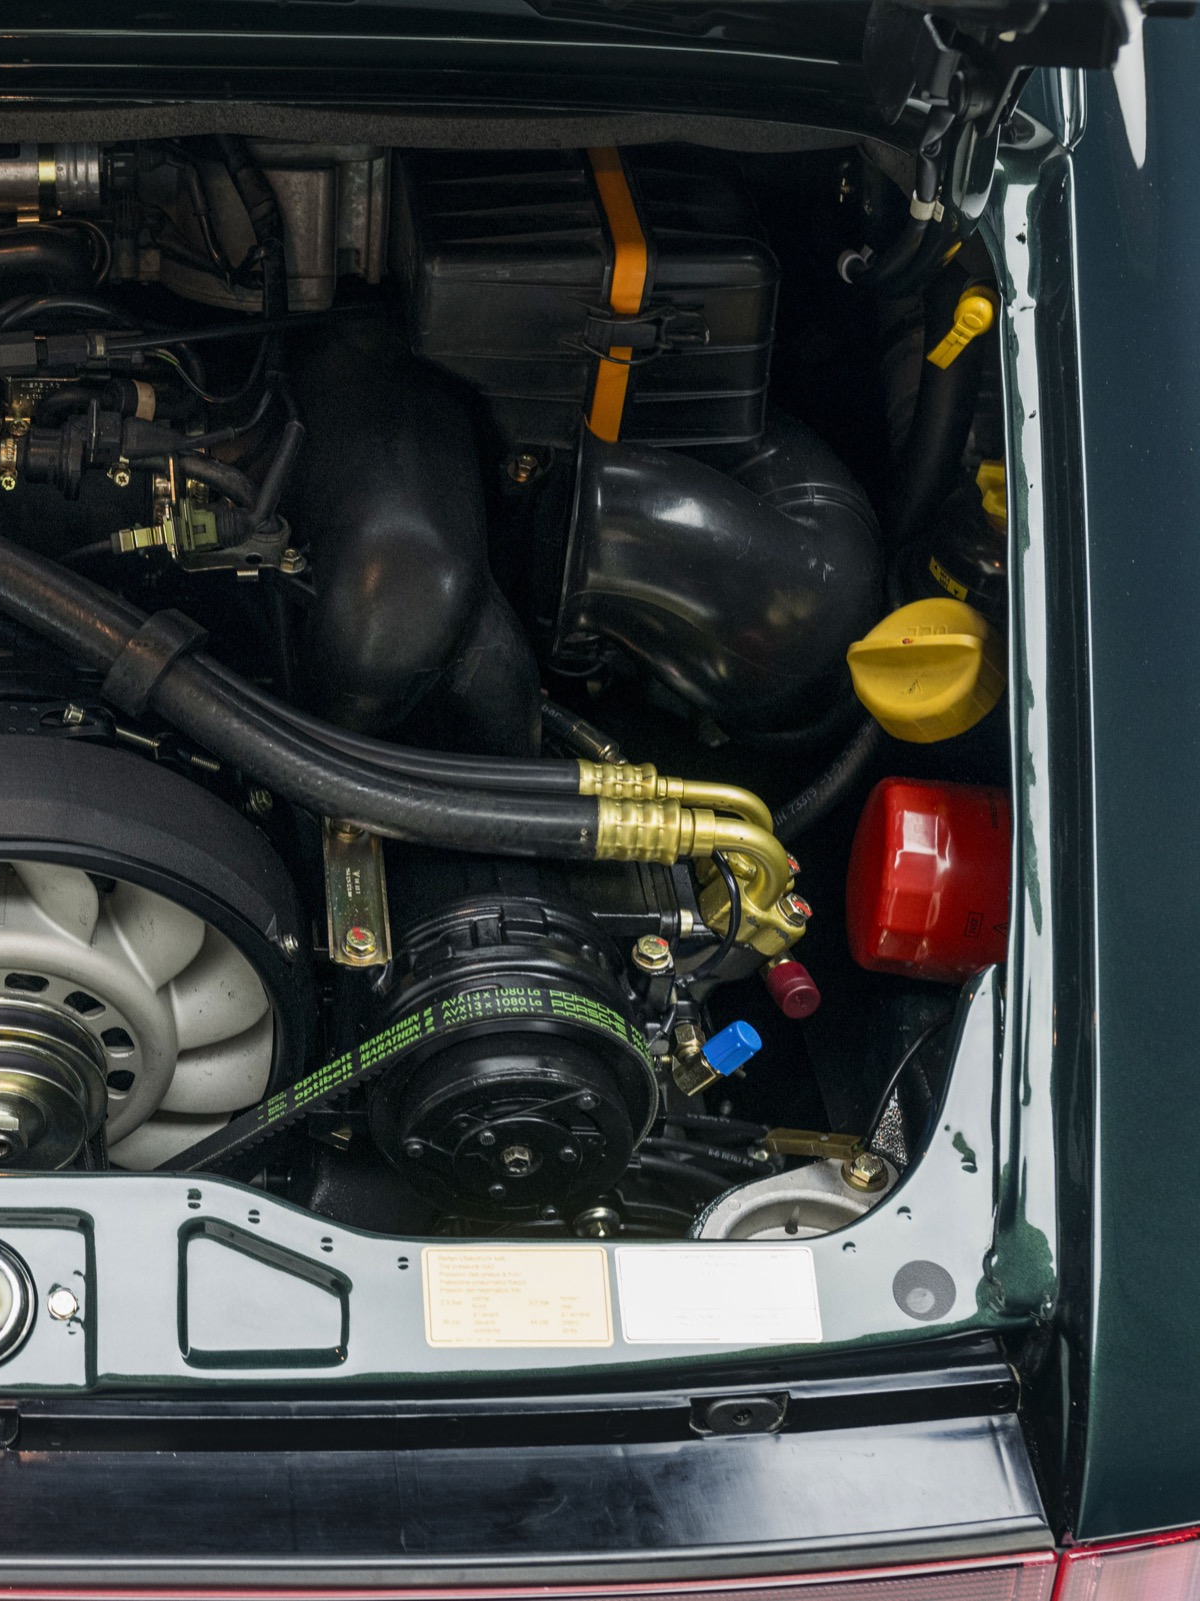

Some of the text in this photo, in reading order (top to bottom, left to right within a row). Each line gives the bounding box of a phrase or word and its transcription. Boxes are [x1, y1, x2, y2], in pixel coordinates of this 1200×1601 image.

[541, 703, 563, 718] bar
[442, 1002, 482, 1019] AVX13
[495, 997, 525, 1007] 1080
[528, 997, 543, 1007] La
[551, 999, 628, 1036] PORSCHE
[293, 1051, 352, 1091] optibelt
[359, 1012, 420, 1053] MARATHON
[294, 1062, 353, 1101] optibelt
[360, 1022, 421, 1063] MARATHON
